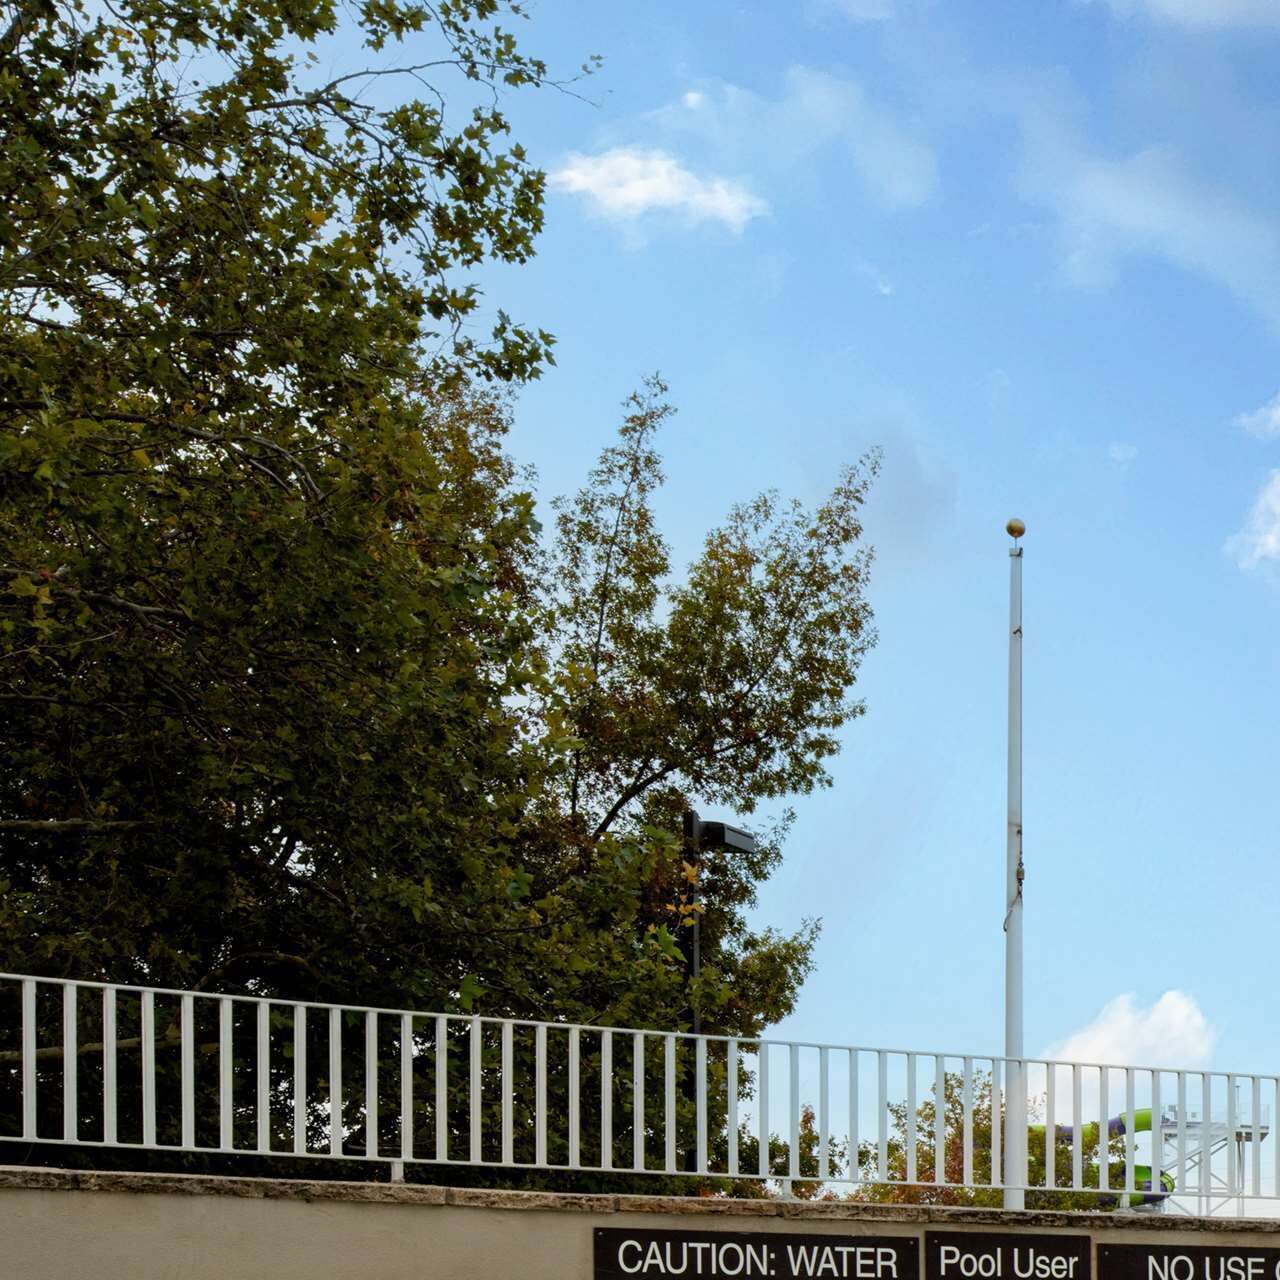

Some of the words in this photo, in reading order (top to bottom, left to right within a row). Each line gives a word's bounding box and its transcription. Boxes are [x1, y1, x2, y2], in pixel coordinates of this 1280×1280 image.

[618, 1240, 776, 1275] CAUTION:
[787, 1246, 898, 1278] WATER
[940, 1246, 1001, 1277] Pool
[1013, 1247, 1078, 1279] User
